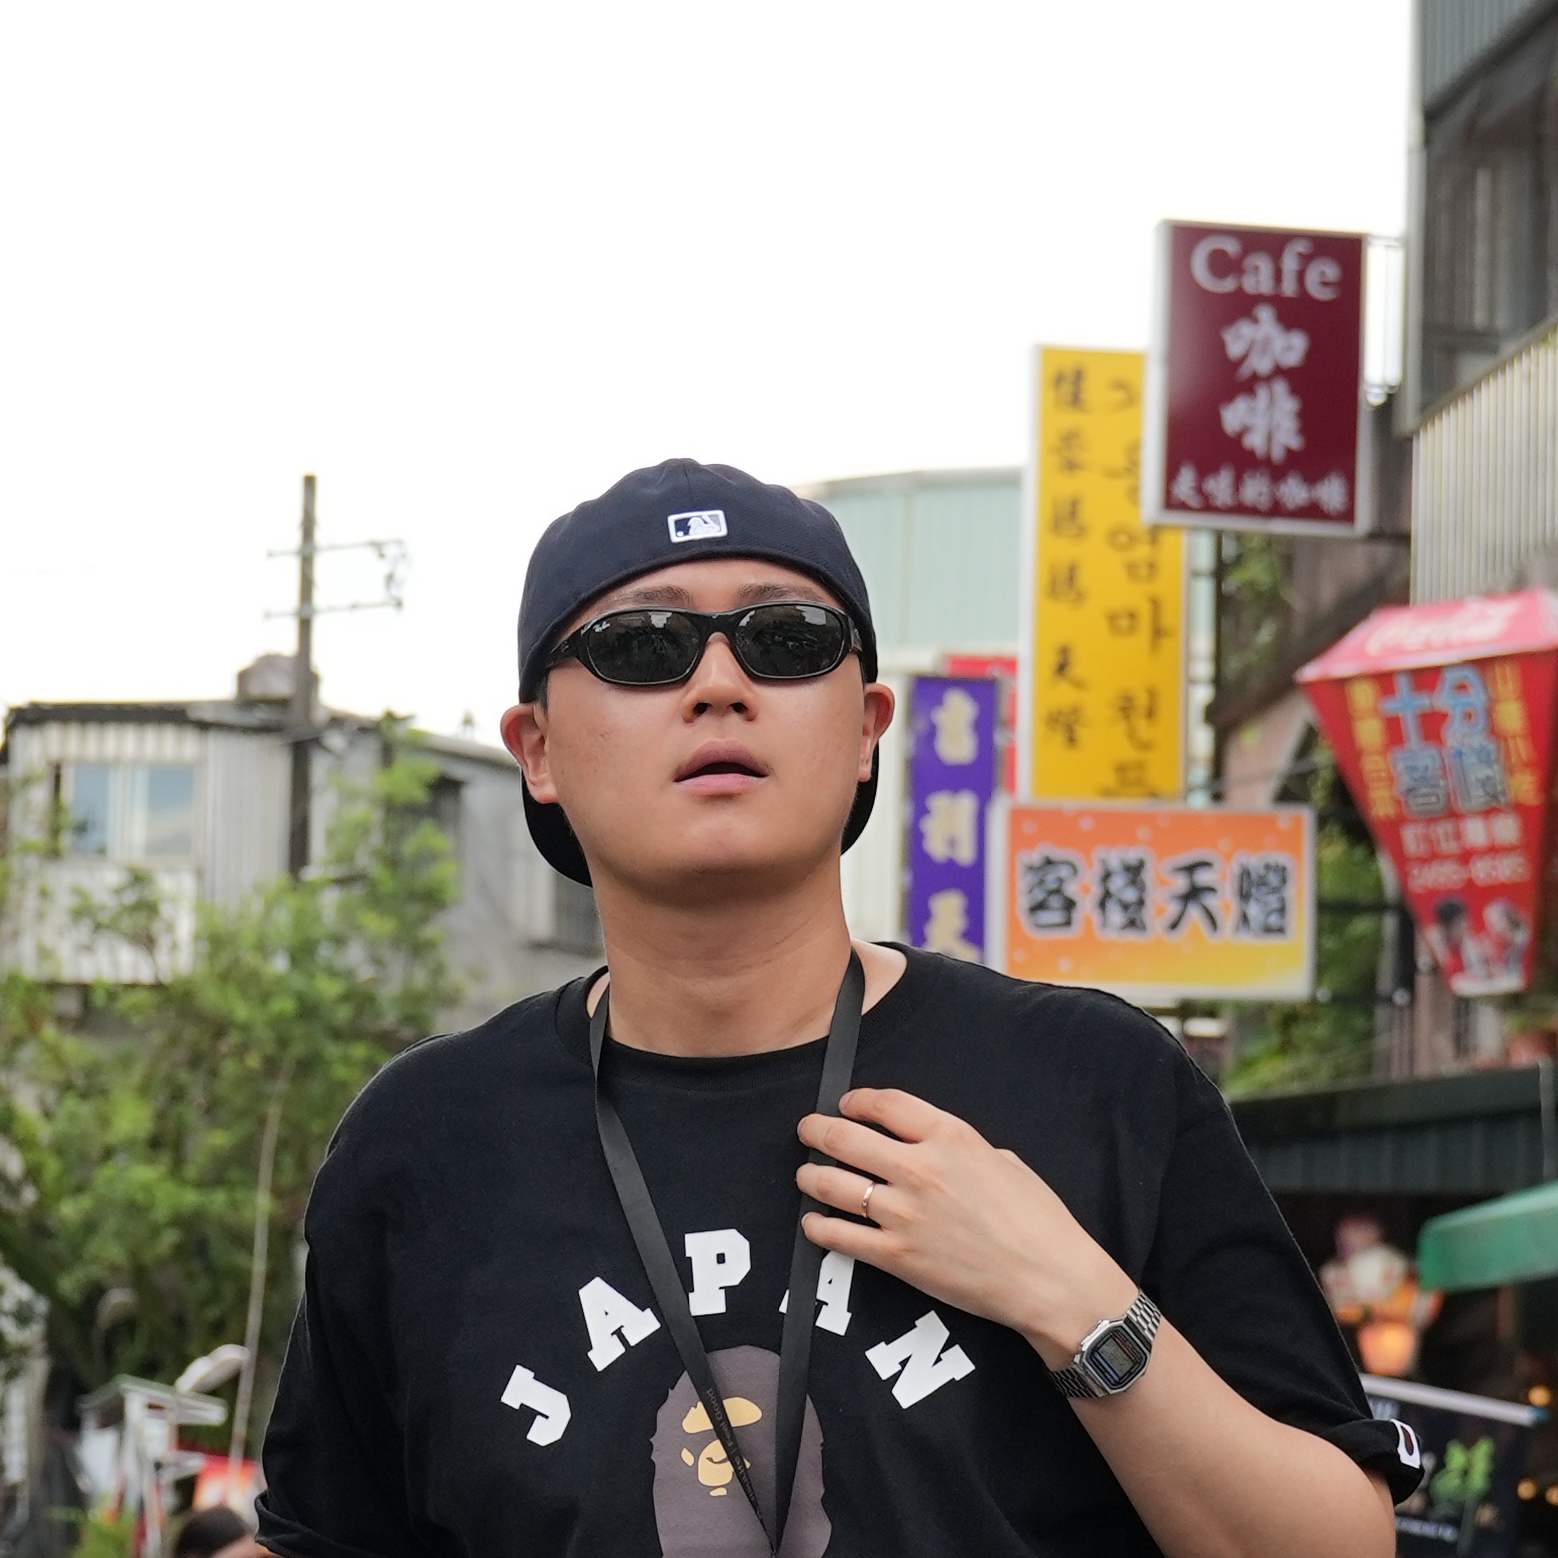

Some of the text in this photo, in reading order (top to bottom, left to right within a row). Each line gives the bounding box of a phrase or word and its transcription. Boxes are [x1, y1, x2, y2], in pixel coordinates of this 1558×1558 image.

[1190, 234, 1342, 302] Cafe
[1219, 303, 1310, 465] 咖啡
[1023, 853, 1291, 937] 客棧天燈
[500, 1228, 976, 1447] JAPAN
[707, 1388, 724, 1421] Good
